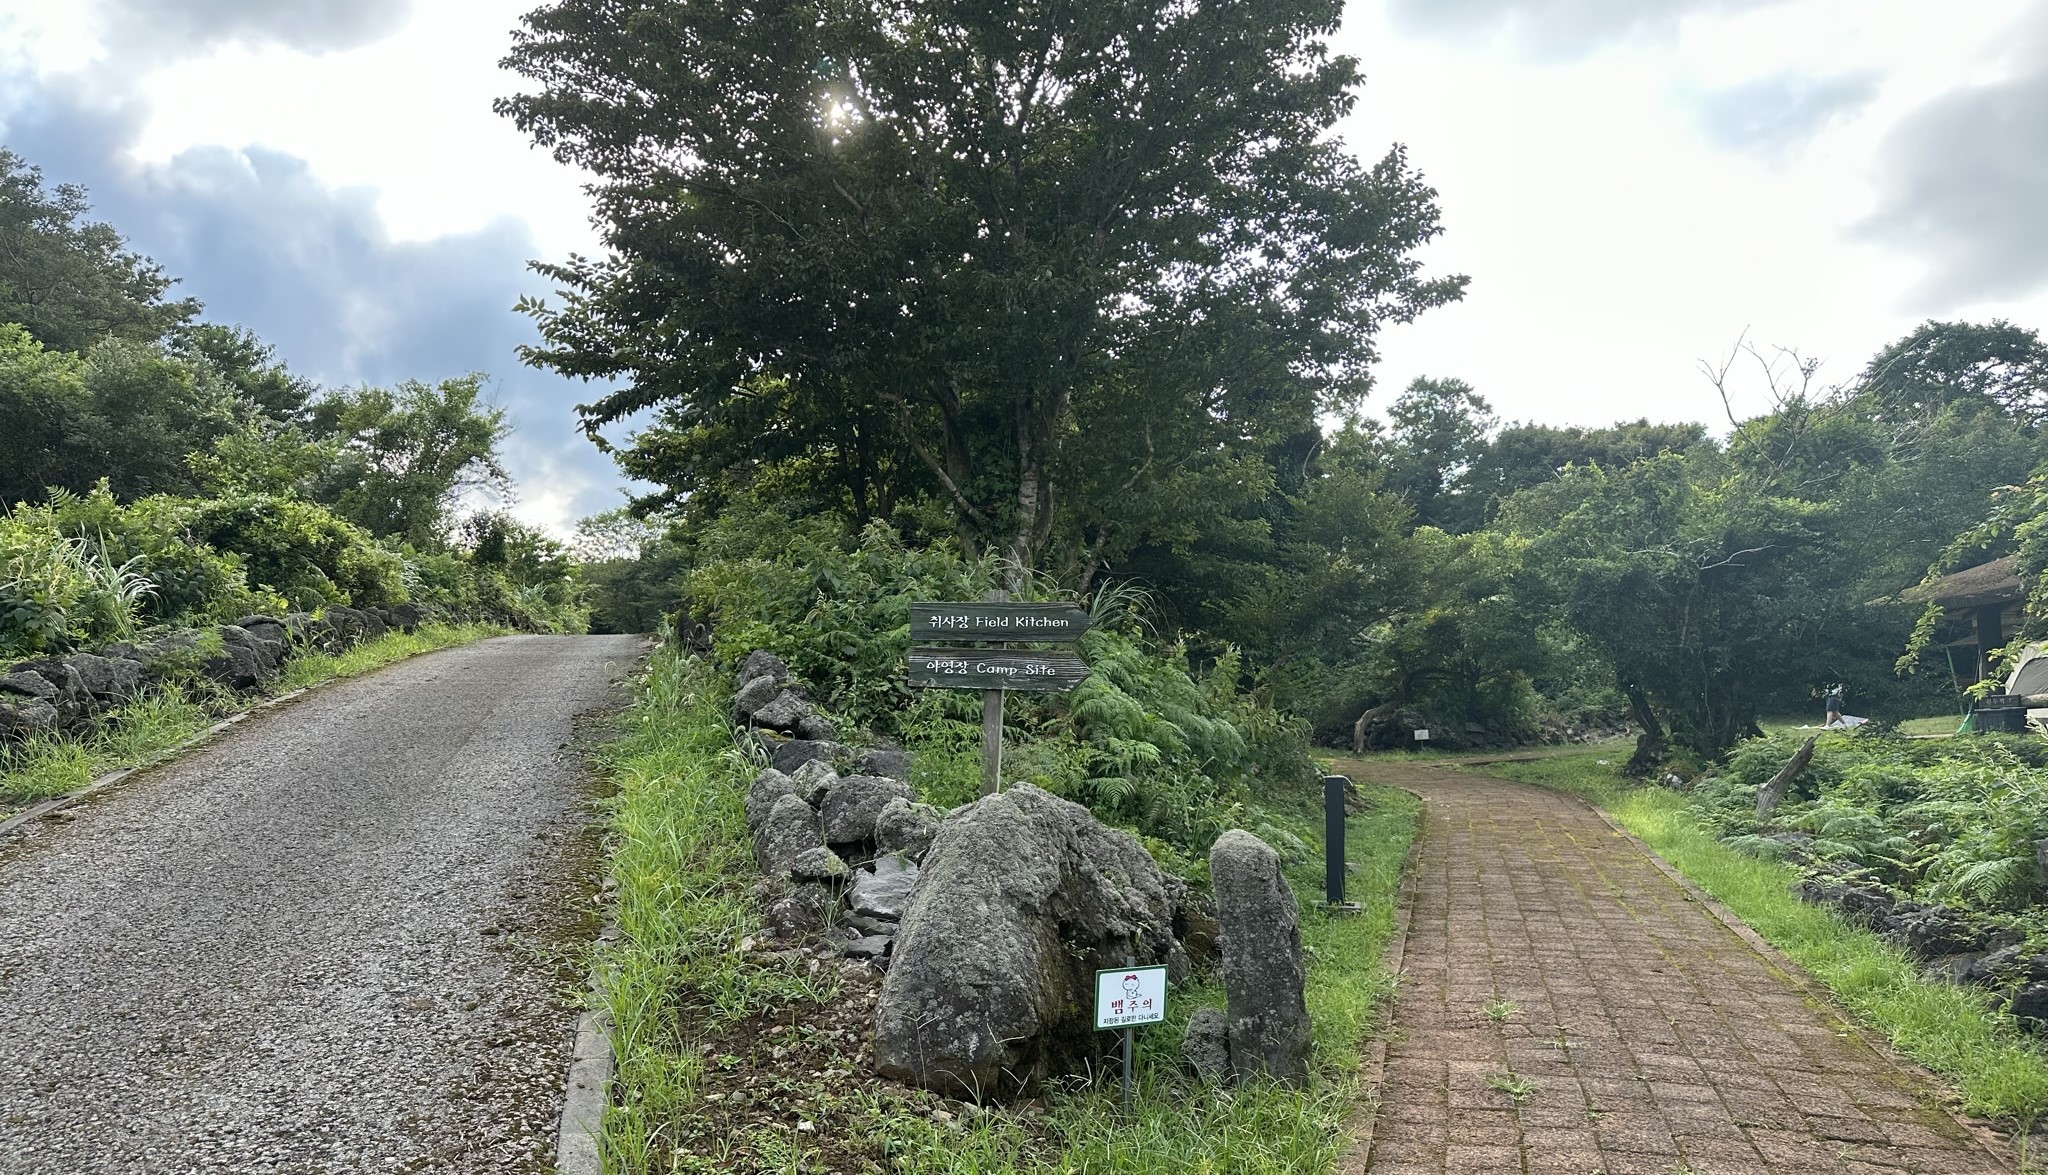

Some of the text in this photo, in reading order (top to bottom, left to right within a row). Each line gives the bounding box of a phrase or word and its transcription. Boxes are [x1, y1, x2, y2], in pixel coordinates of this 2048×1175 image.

[929, 615, 1069, 629] 취사장 Field Kitchen
[926, 659, 1056, 677] 야영장 Camp Site
[1103, 1016, 1120, 1025] 지정된
